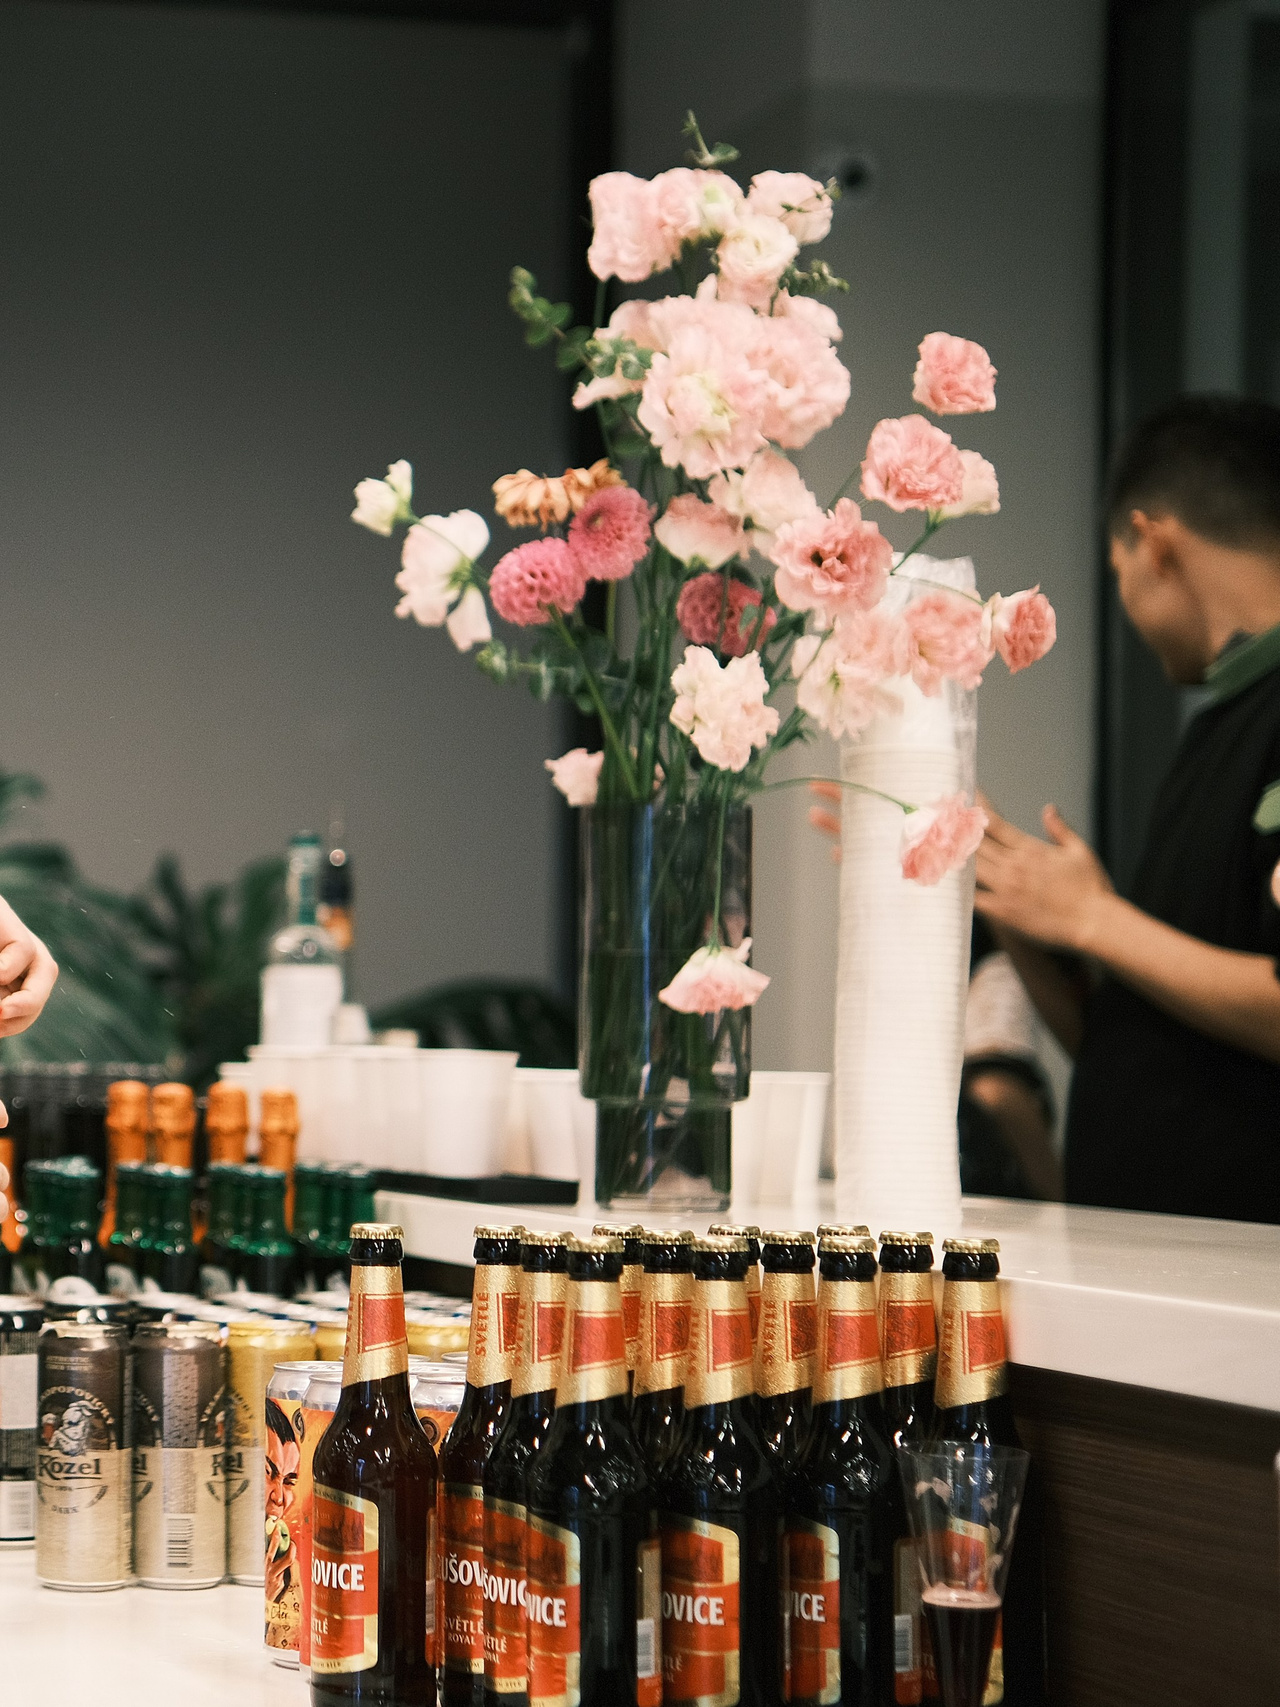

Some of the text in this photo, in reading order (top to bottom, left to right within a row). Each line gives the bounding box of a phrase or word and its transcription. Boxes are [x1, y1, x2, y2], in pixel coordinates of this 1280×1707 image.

[38, 1454, 102, 1480] Kozel
[437, 1552, 484, 1587] UŠOV
[662, 1591, 725, 1626] OVICE
[791, 1592, 826, 1623] ICE
[448, 1632, 476, 1646] ROYAL
